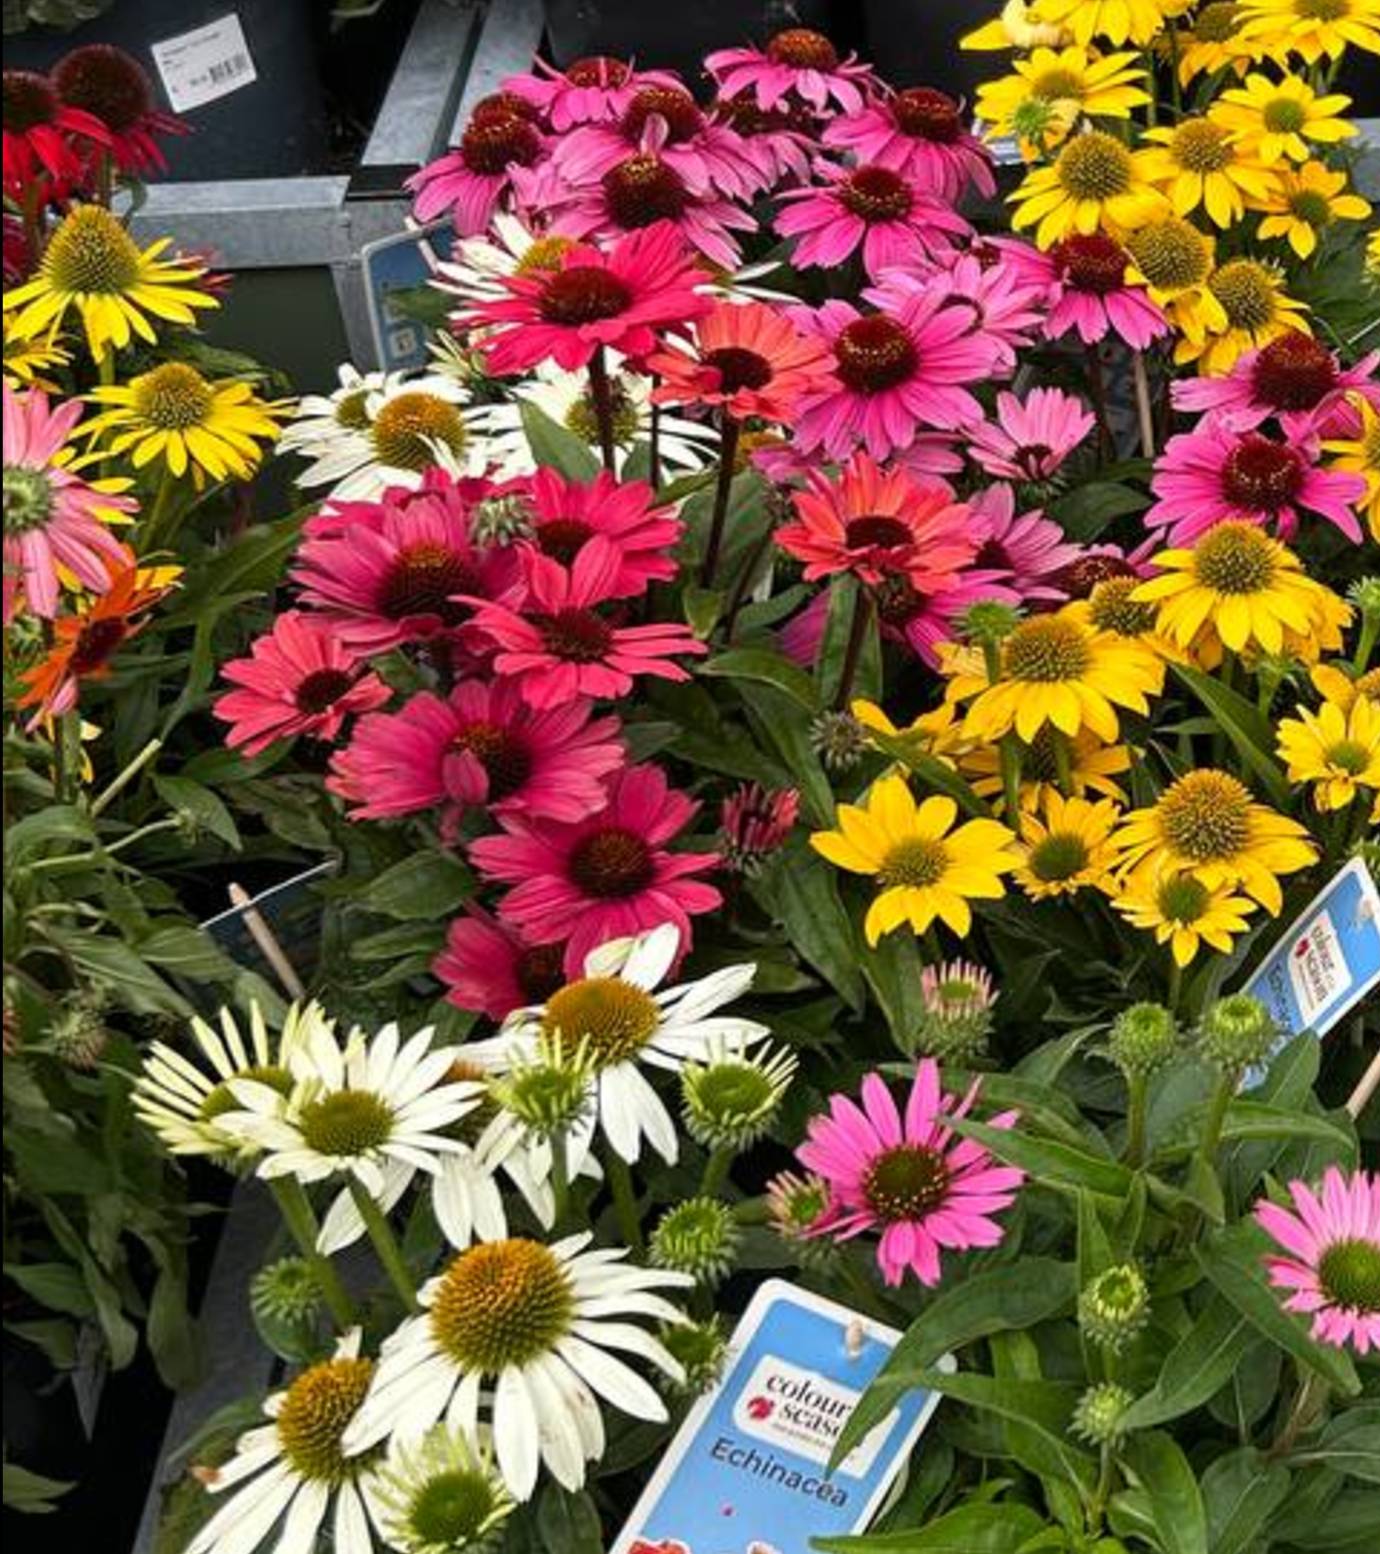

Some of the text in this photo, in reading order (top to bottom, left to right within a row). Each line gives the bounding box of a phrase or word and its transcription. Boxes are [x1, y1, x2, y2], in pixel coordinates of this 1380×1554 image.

[766, 1374, 852, 1418] colour
[779, 1402, 840, 1437] seas
[711, 1437, 849, 1508] Echinacea
